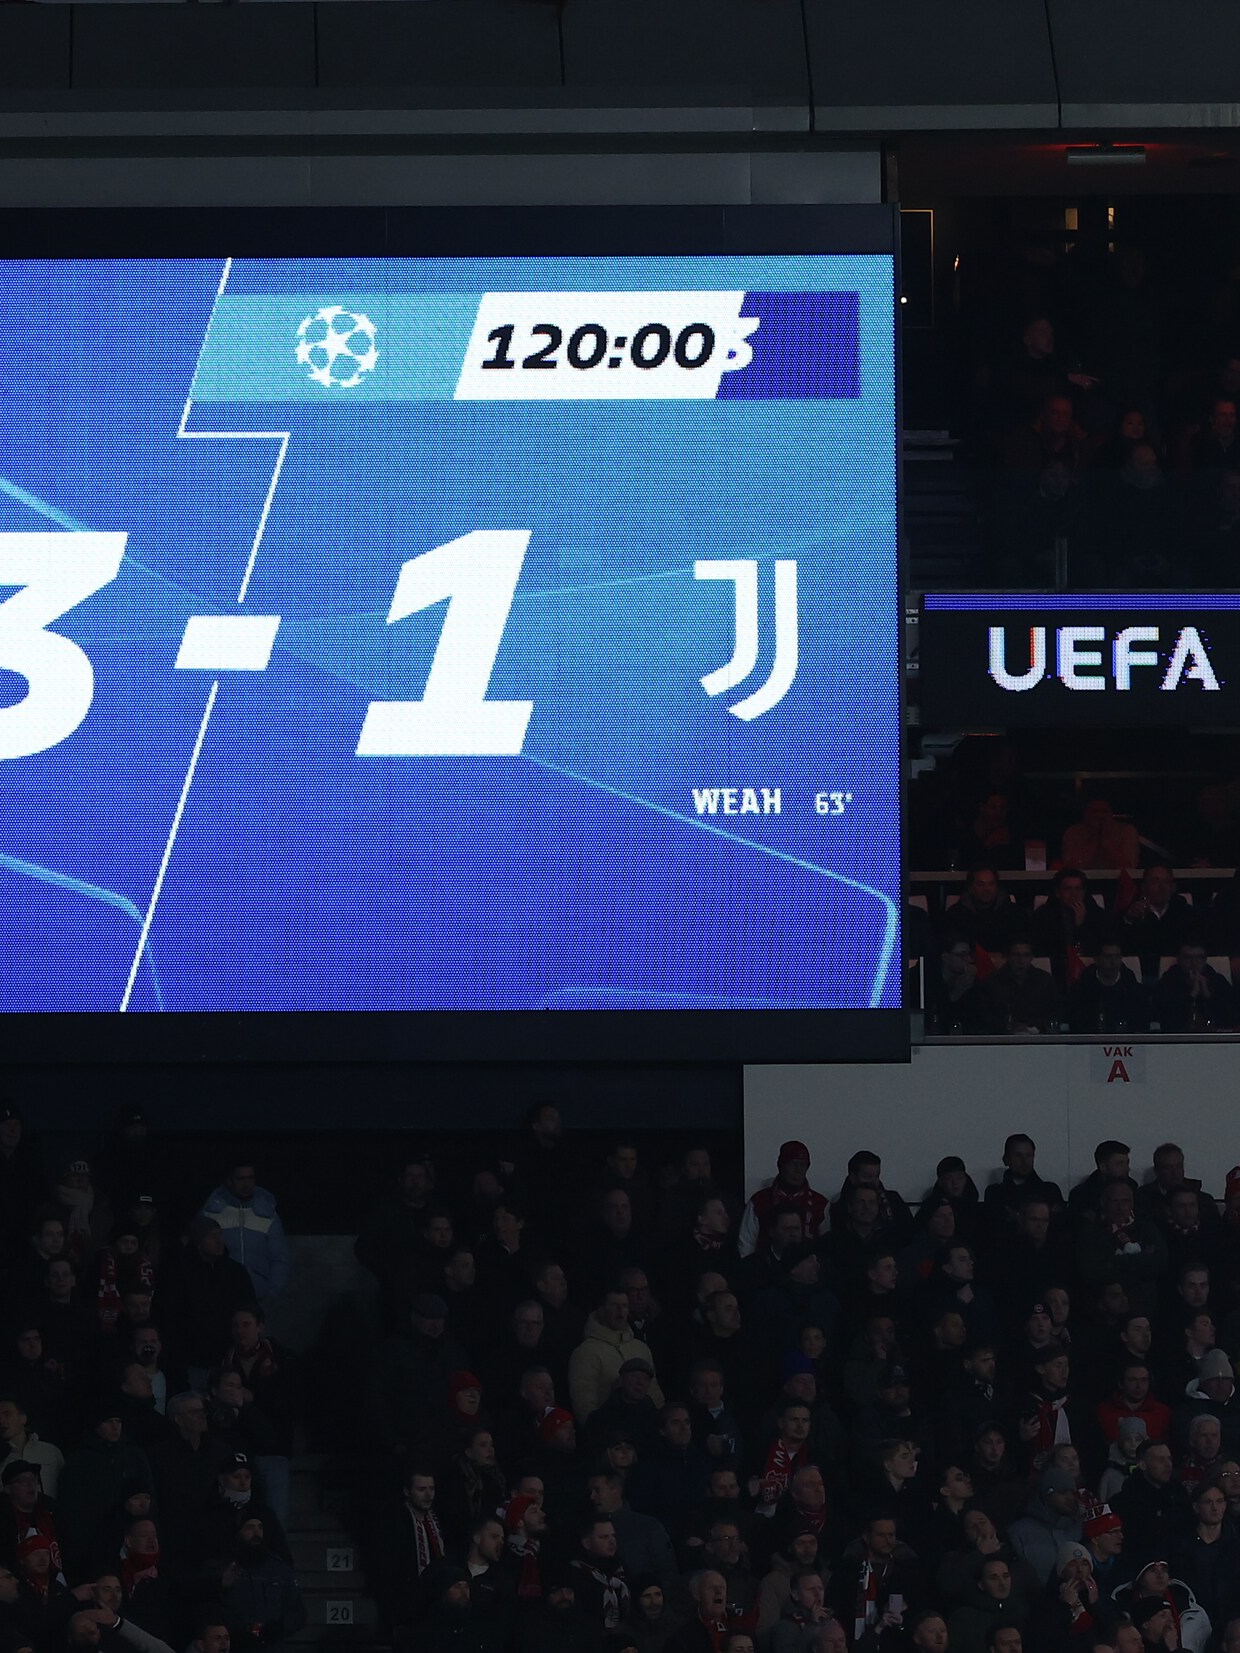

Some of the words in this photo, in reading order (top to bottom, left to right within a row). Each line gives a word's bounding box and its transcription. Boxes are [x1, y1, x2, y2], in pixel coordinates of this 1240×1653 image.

[480, 322, 716, 370] 120:00
[354, 529, 534, 757] 1
[988, 626, 1222, 691] UEFA
[691, 787, 782, 815] WEAH
[814, 792, 854, 815] 63'
[1103, 1046, 1133, 1057] VAK
[1107, 1060, 1130, 1083] A
[330, 1554, 351, 1569] 21
[329, 1607, 351, 1621] 20
